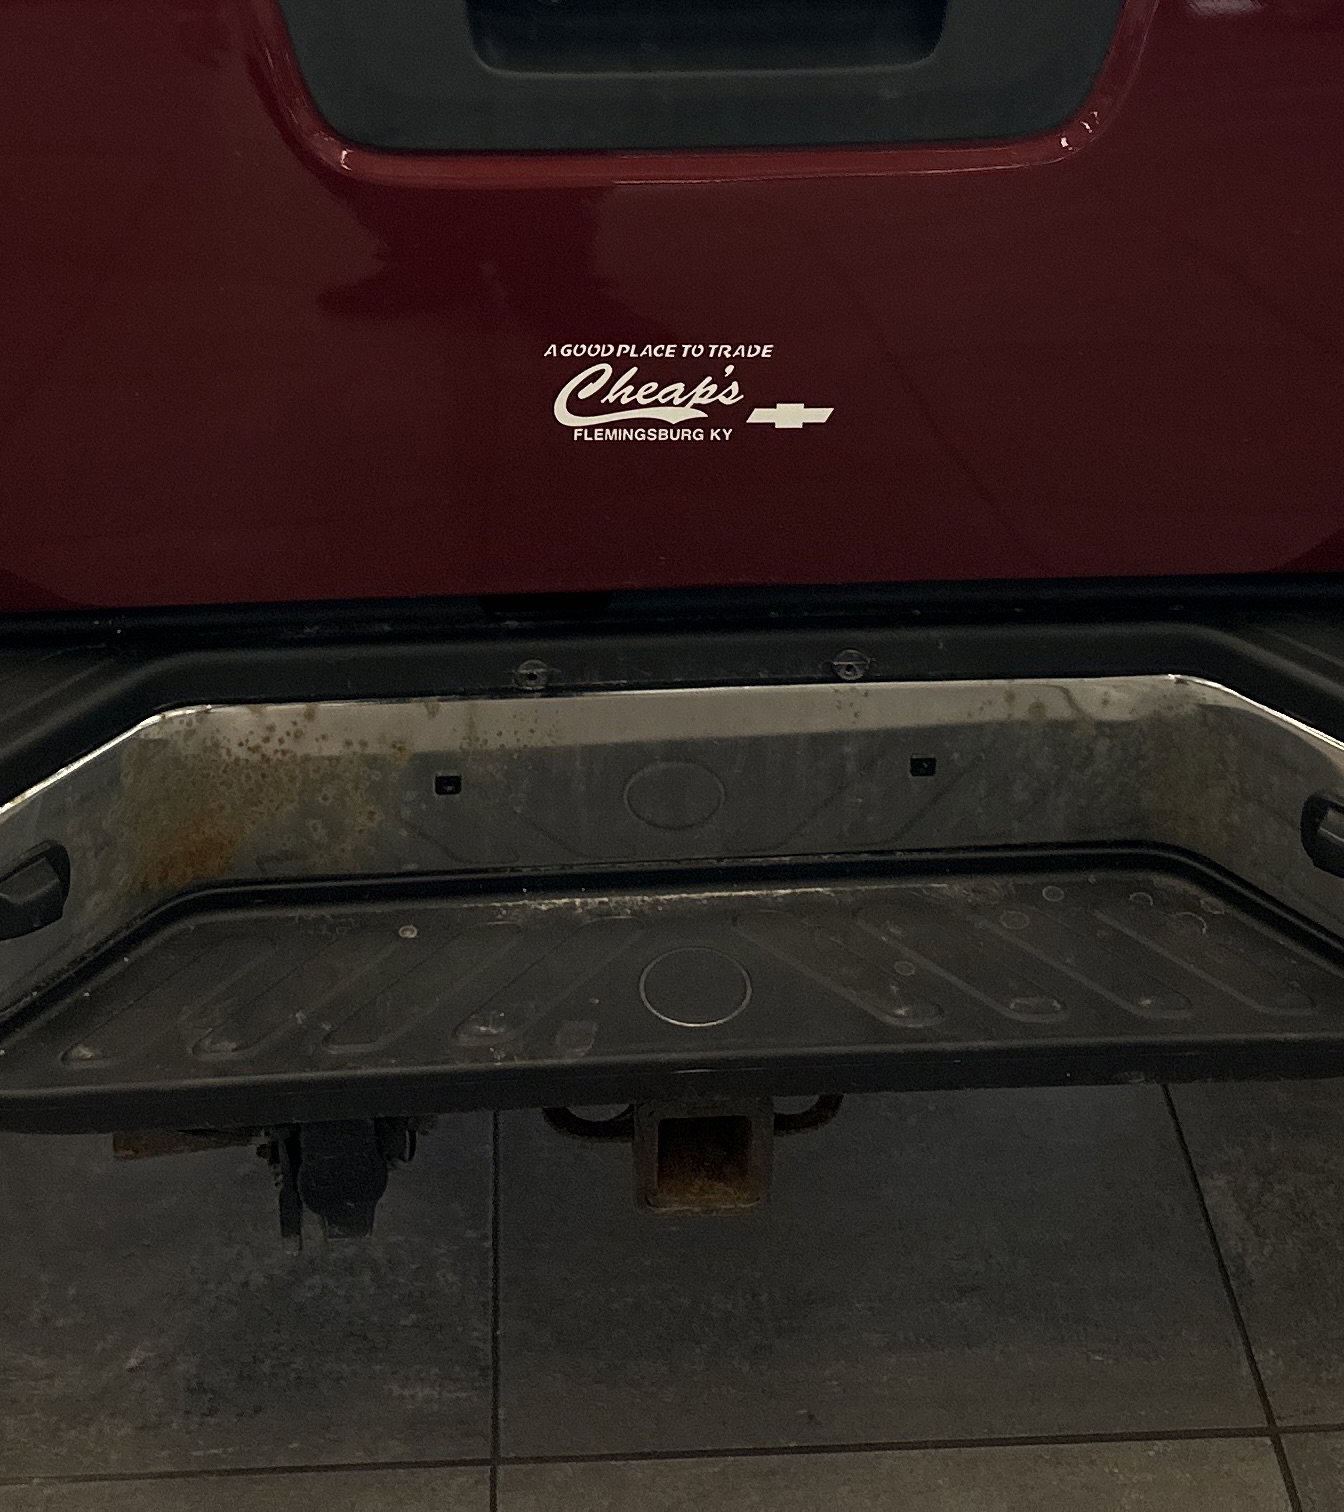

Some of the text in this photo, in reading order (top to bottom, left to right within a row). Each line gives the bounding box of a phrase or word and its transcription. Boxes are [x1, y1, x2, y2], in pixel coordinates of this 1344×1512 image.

[544, 343, 774, 359] A GOOD PLACE TO TRADE
[554, 363, 744, 427] Cheap's
[573, 428, 733, 442] FLEMINGSBURG KY
